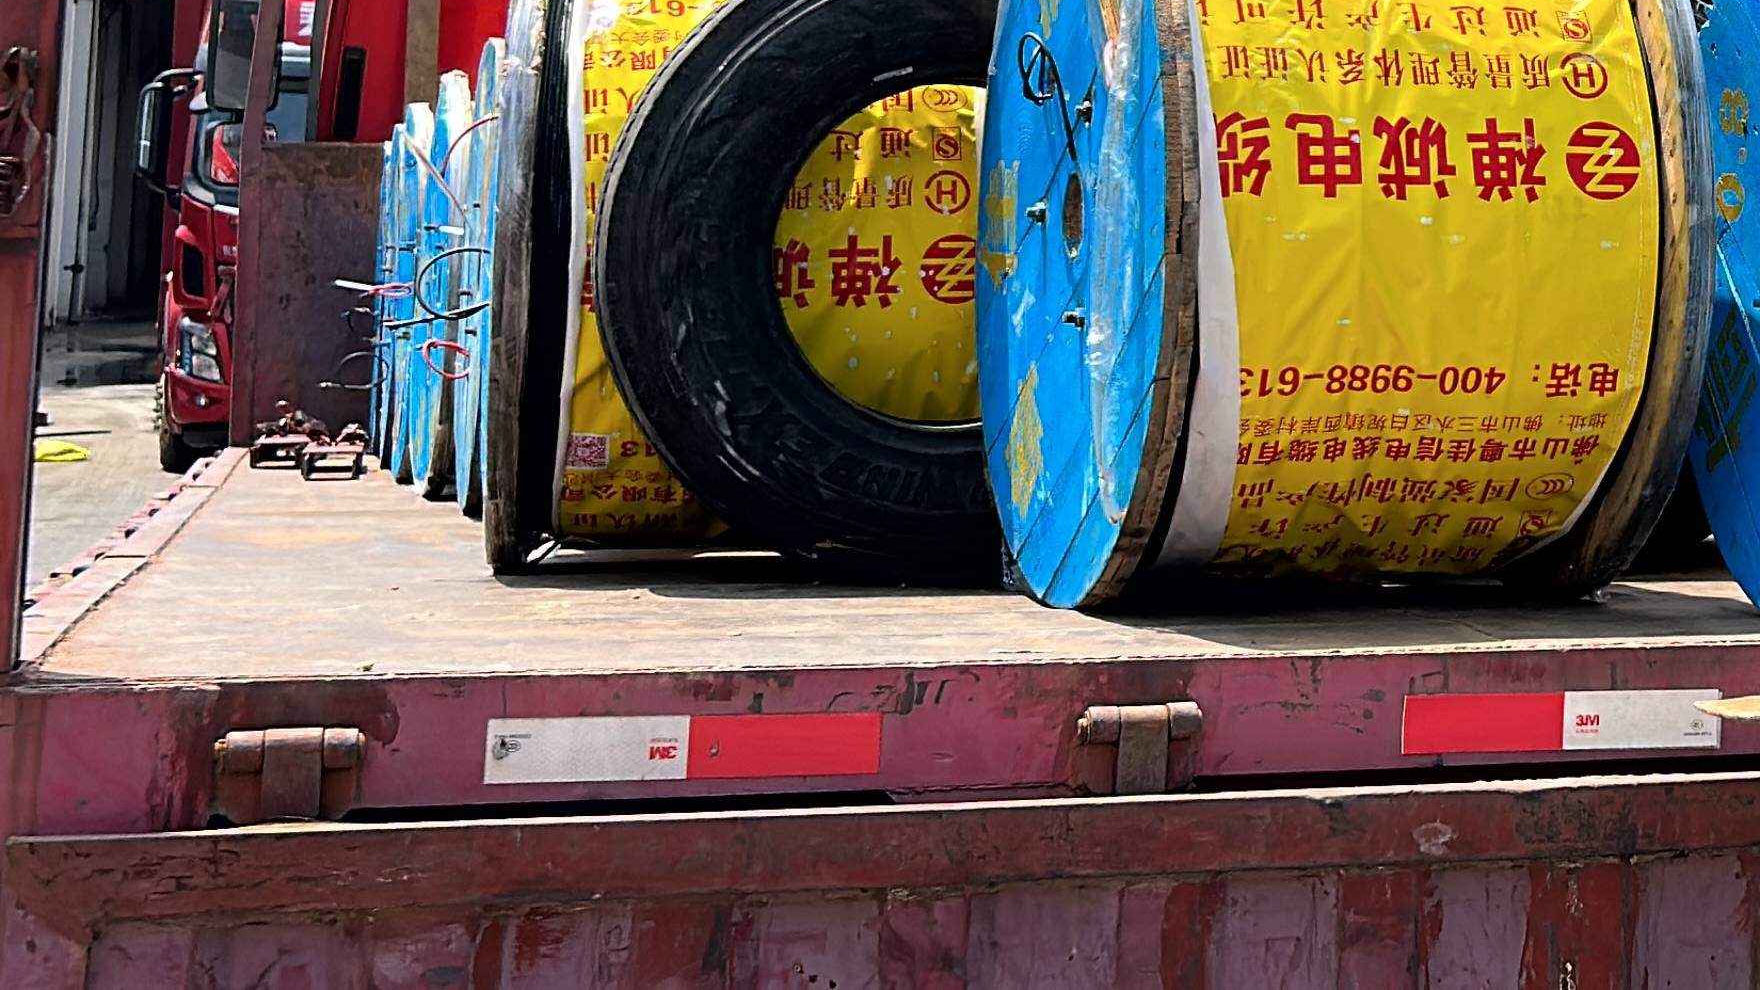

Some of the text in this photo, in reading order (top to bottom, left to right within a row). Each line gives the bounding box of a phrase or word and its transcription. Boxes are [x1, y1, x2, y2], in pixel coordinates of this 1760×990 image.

[1212, 111, 1547, 204] 禅诚电缆
[1238, 363, 1507, 399] 400-9988-613
